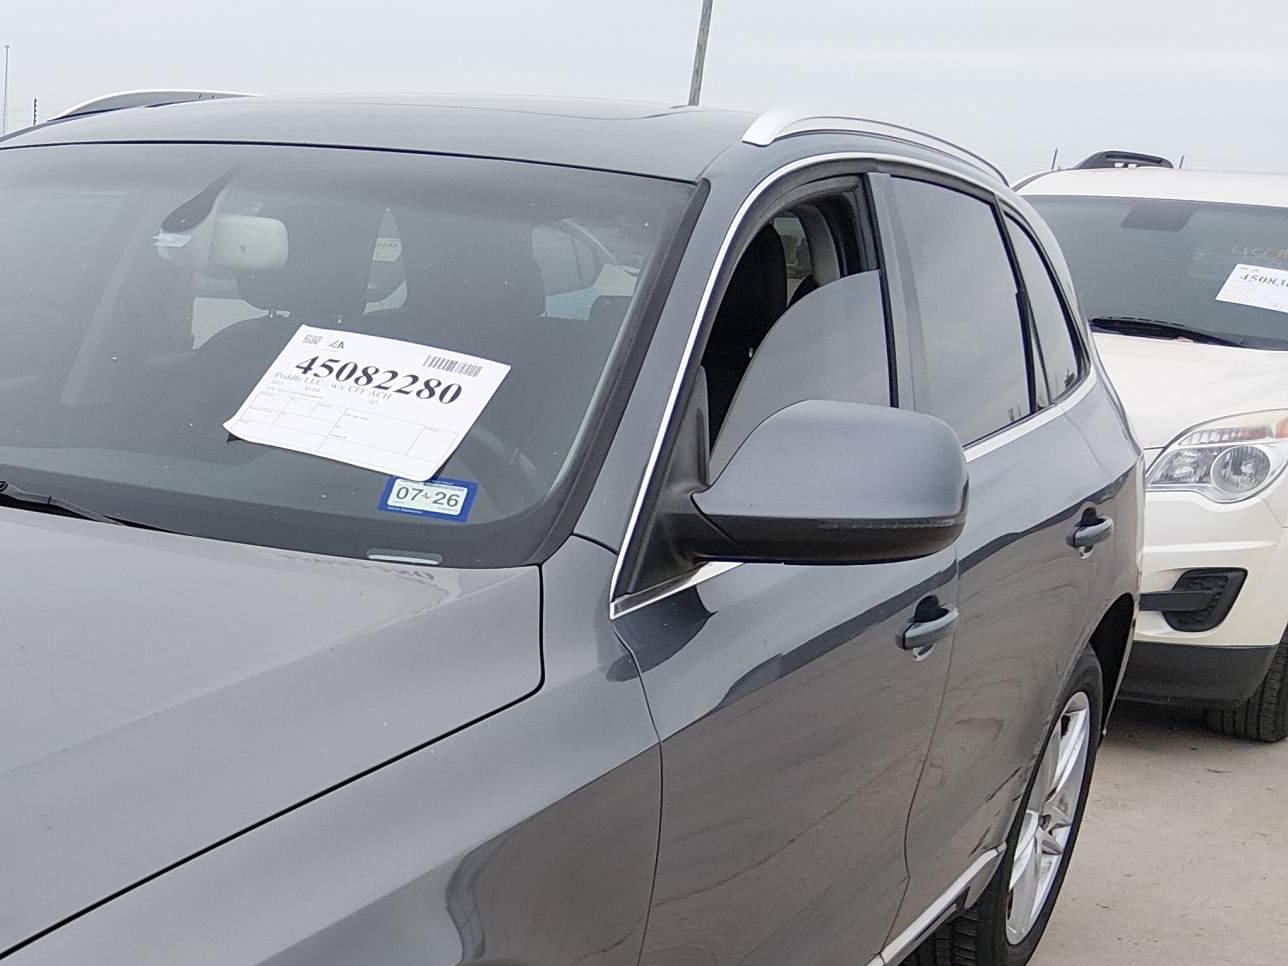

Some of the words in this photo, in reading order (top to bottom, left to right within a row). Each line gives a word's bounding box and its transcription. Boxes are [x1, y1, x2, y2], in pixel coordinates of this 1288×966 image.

[1240, 273, 1288, 288] 45083
[274, 371, 302, 382] Peddle
[304, 376, 322, 385] LLC
[295, 354, 462, 405] 45082280
